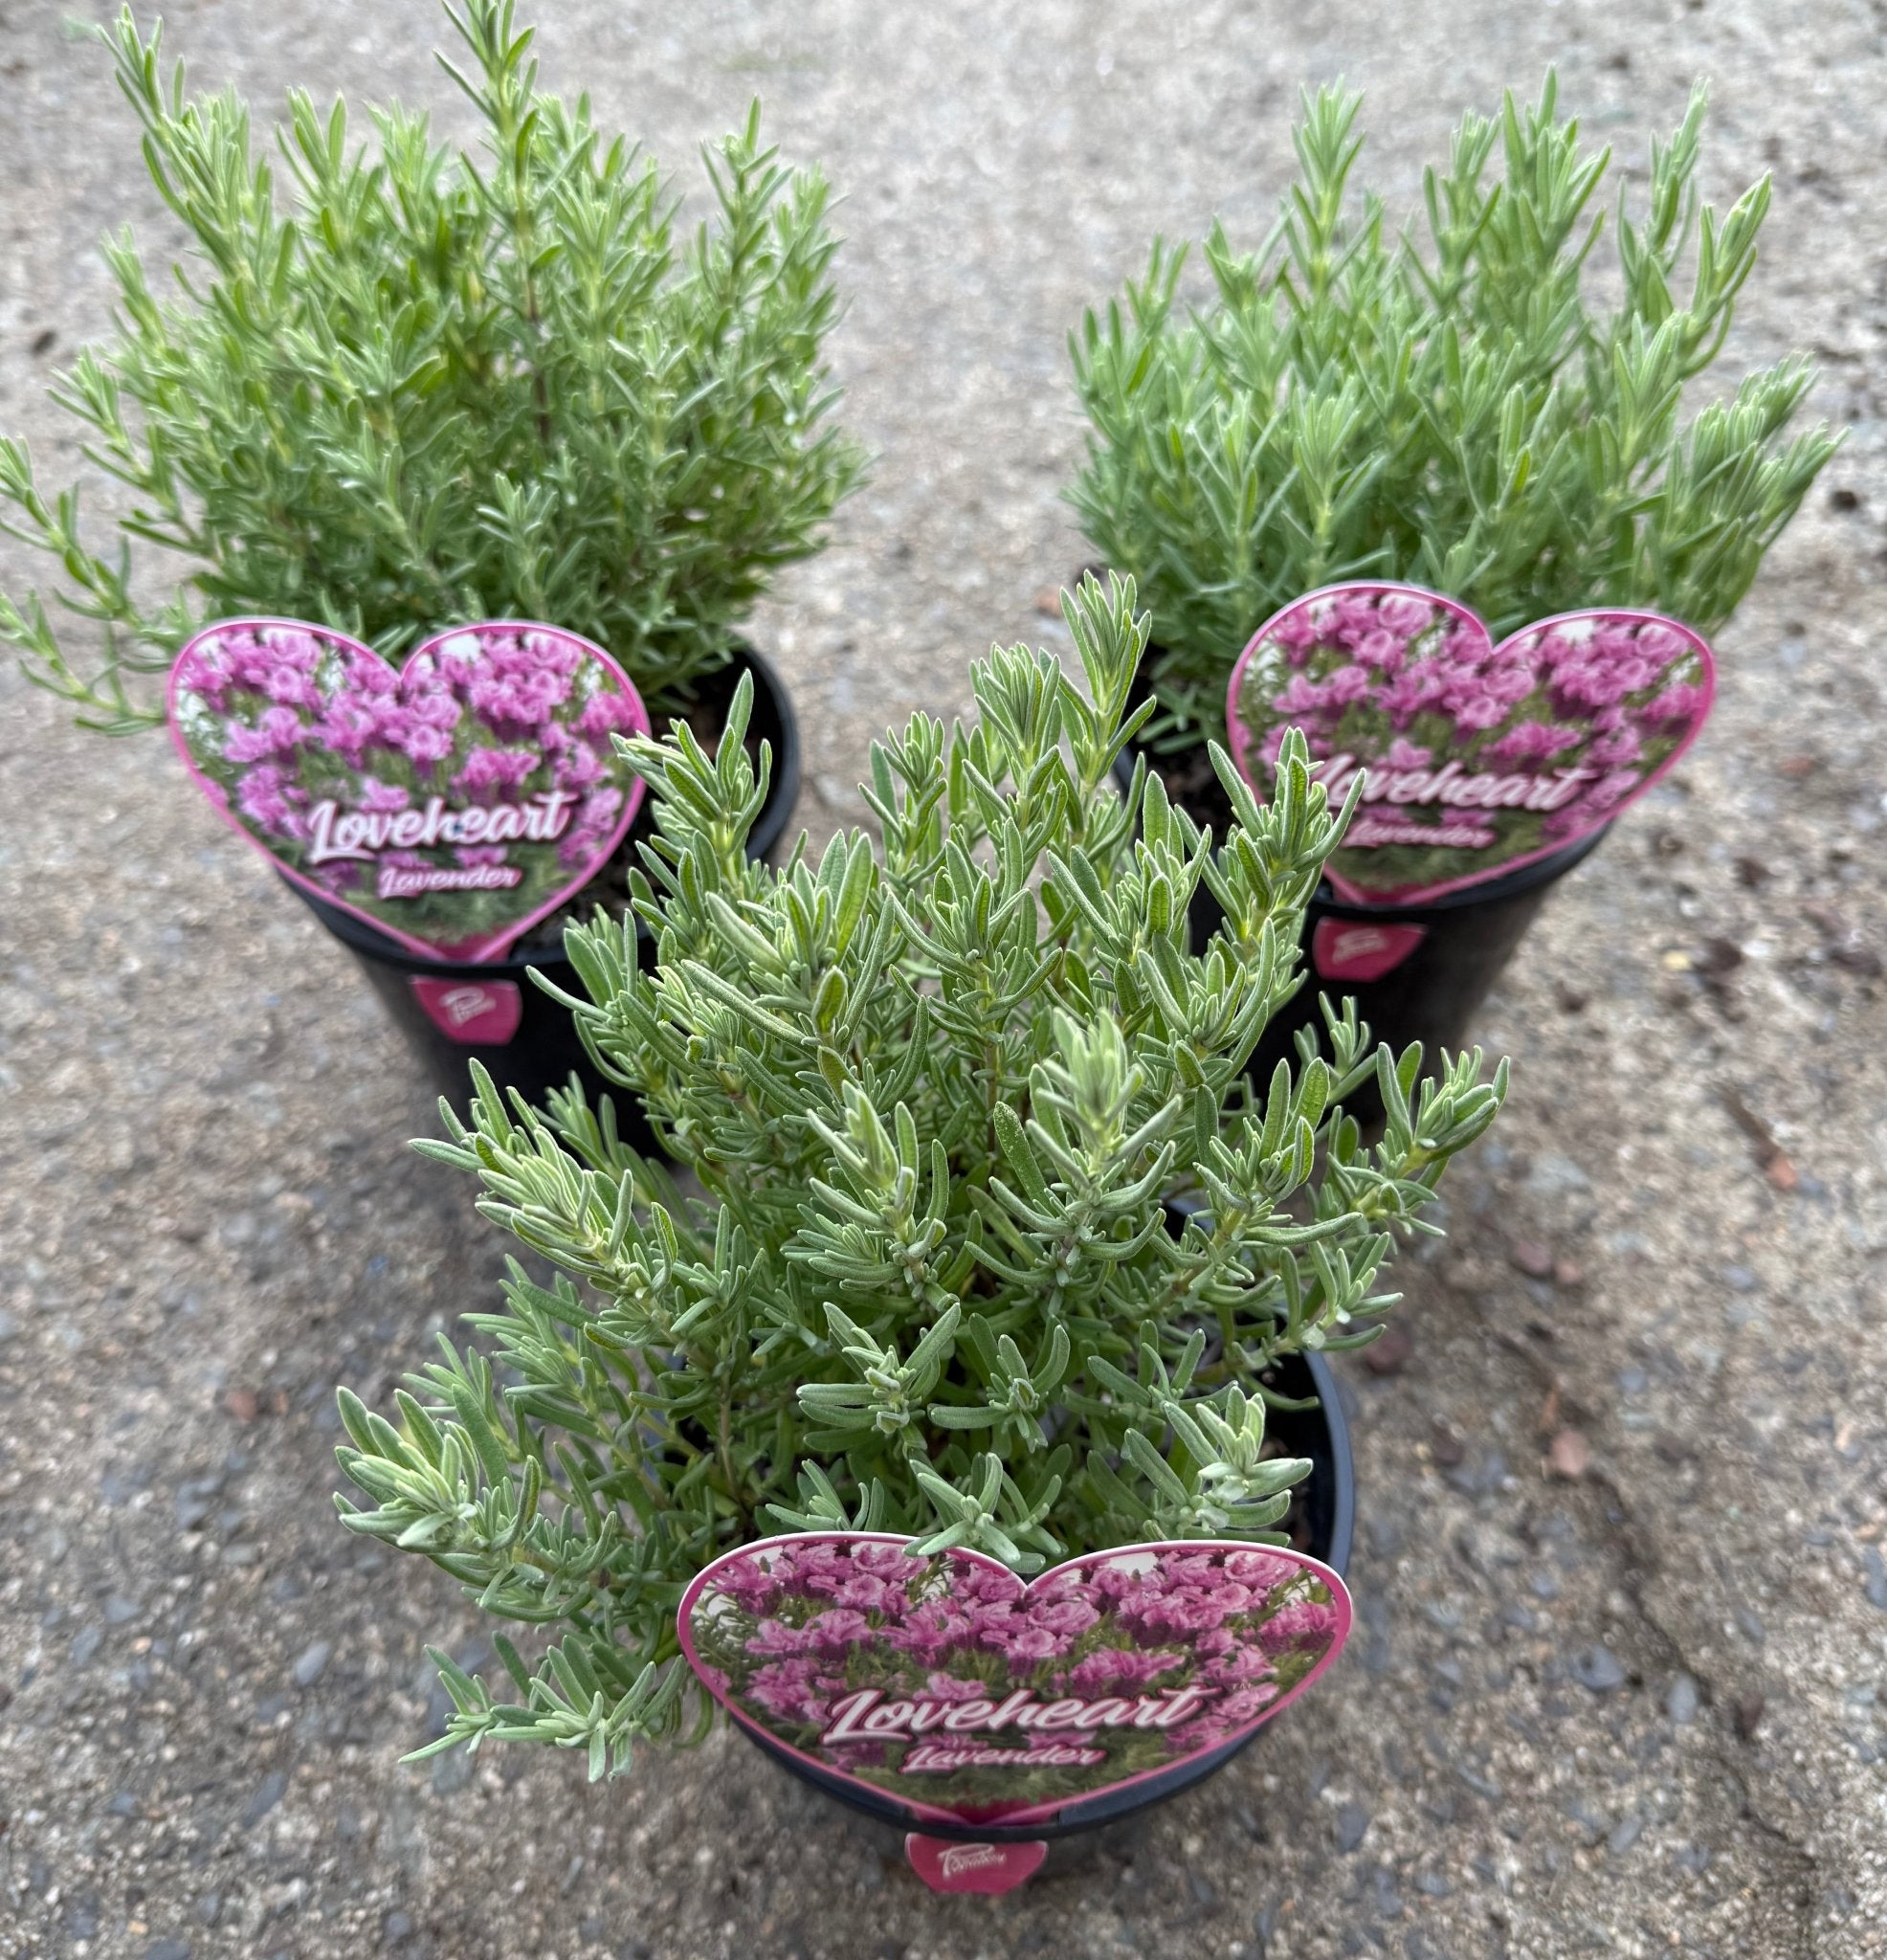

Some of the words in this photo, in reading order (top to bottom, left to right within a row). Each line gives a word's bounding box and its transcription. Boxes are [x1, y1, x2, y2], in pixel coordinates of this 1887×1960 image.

[308, 791, 579, 864] Loveheart
[379, 865, 521, 898] Lavender
[822, 1684, 1221, 1745] Loveheart
[901, 1744, 1105, 1773] Lavender
